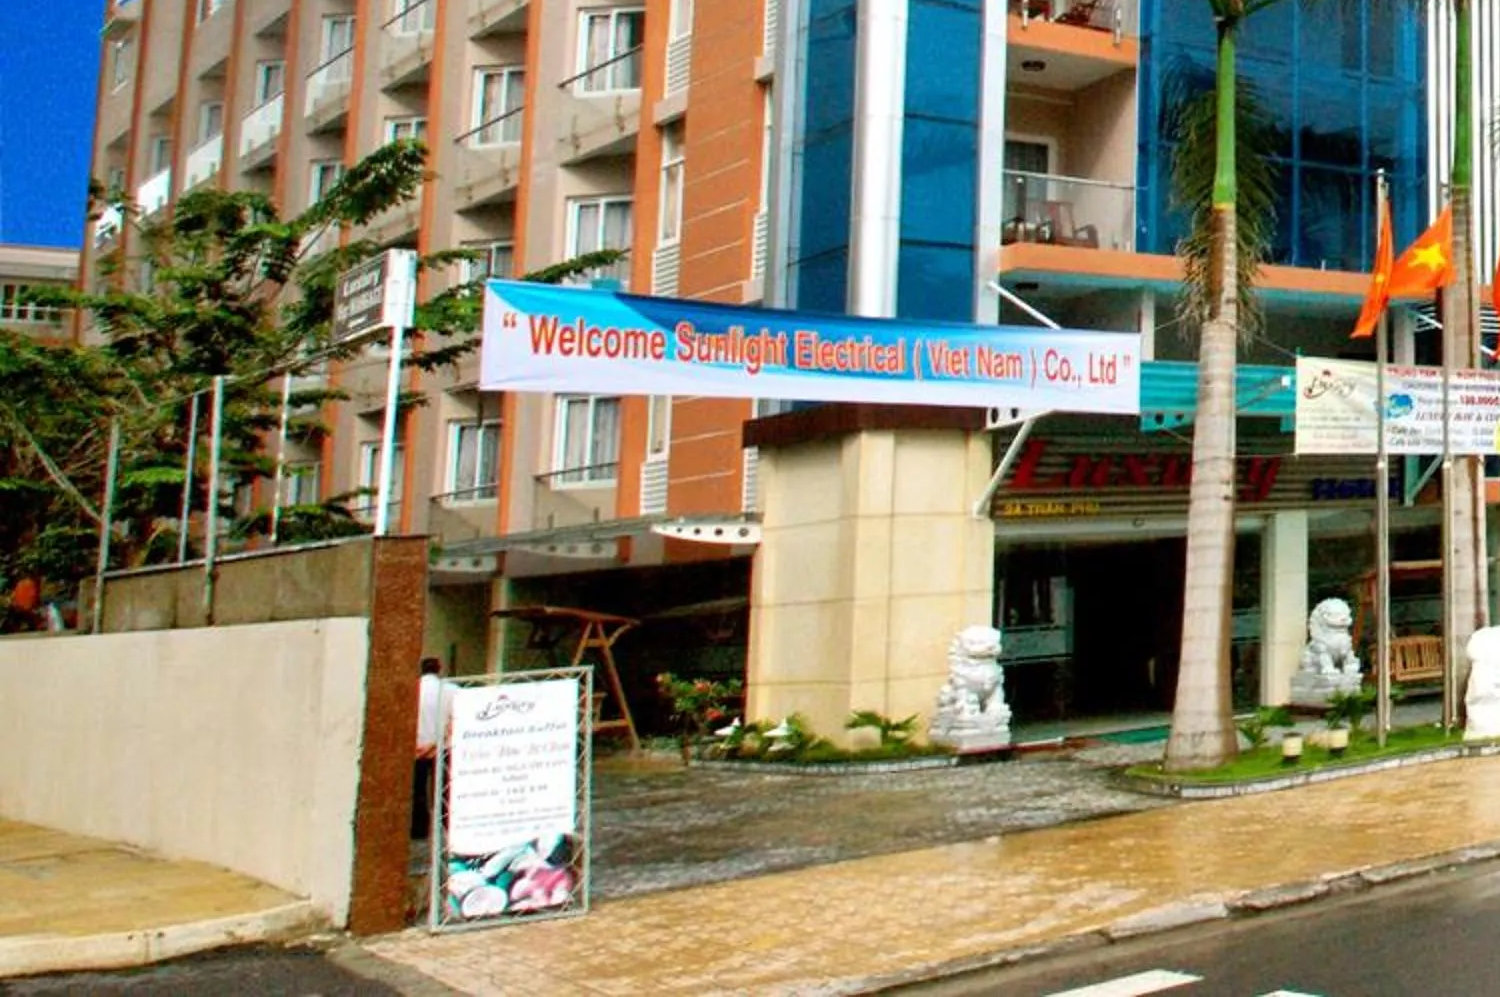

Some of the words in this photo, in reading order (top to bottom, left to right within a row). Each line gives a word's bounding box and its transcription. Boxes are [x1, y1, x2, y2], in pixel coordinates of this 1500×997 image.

[529, 315, 666, 360] Welcome
[676, 321, 787, 375] Sunlight
[795, 330, 905, 374] Electrical
[928, 339, 972, 378] Viet
[975, 344, 1024, 380] Nam
[1089, 352, 1117, 385] Ltd
[1009, 439, 1281, 501] Luxuy
